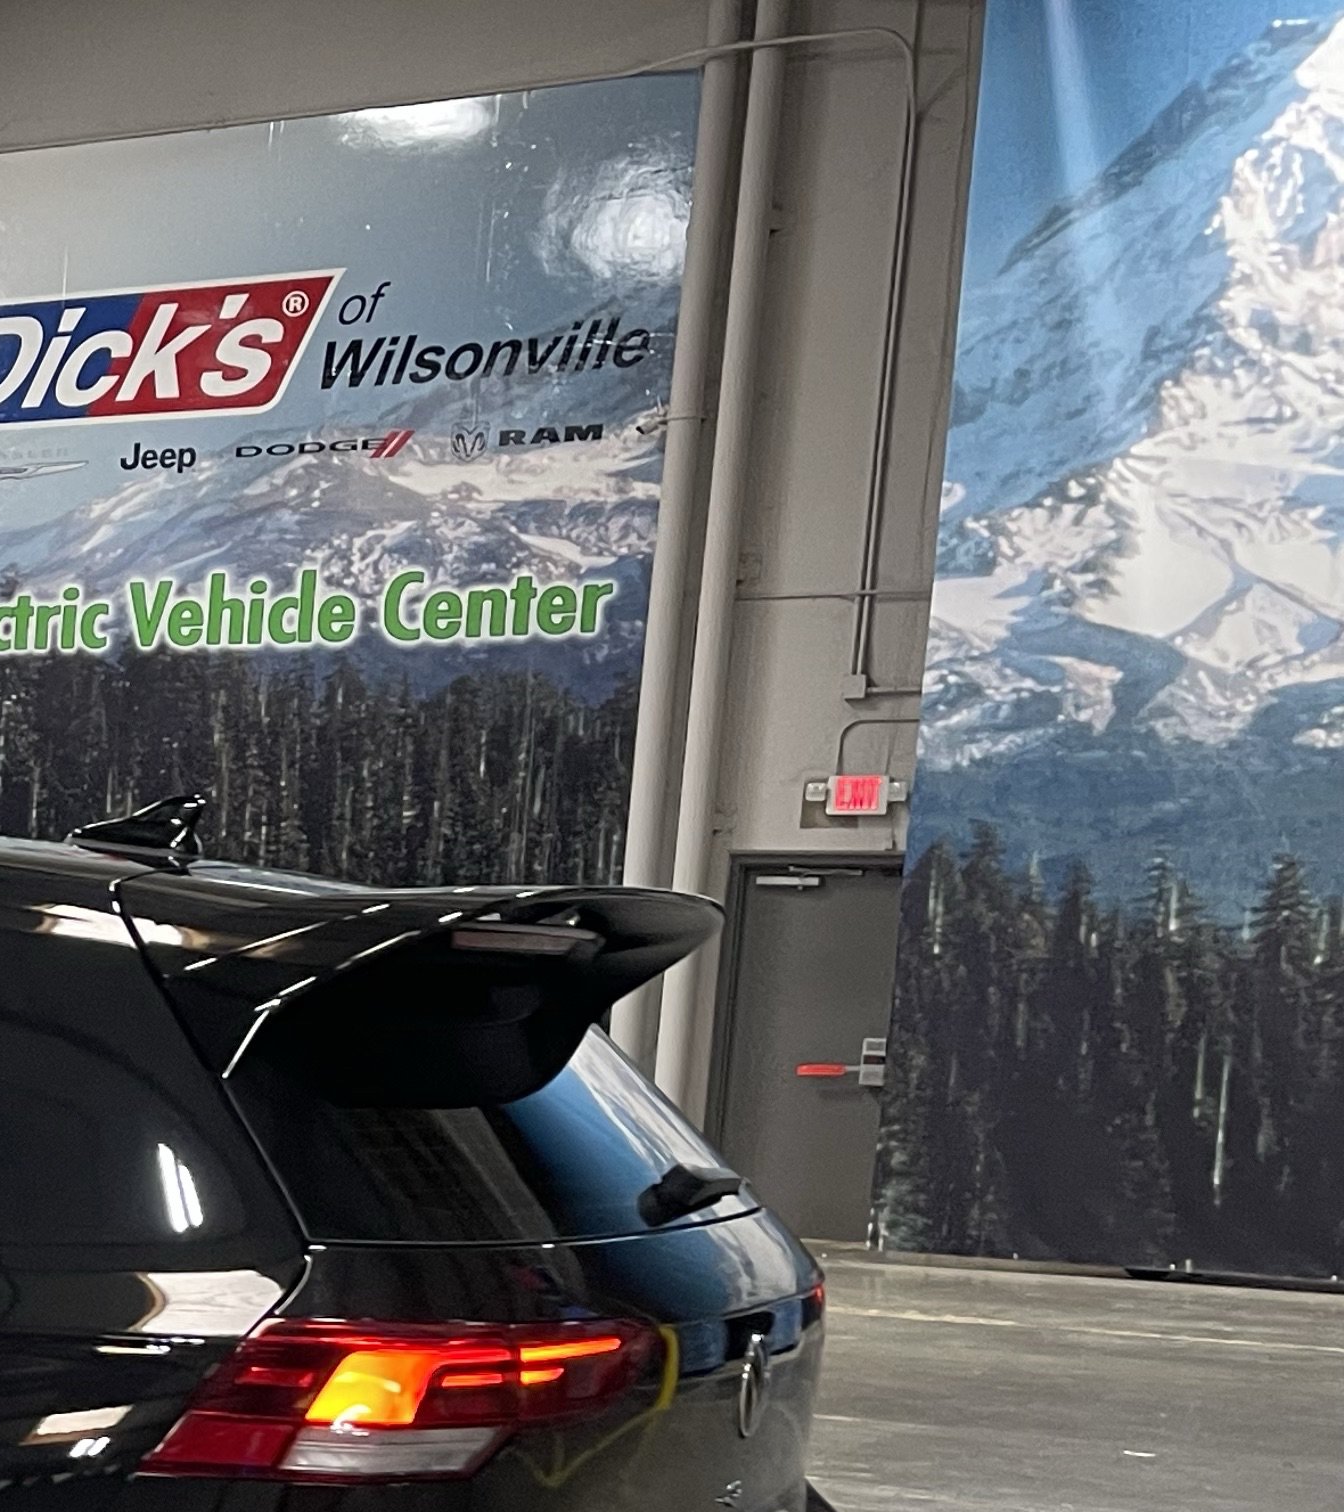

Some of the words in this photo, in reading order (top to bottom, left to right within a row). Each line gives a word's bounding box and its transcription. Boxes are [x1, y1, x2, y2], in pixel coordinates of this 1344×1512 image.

[338, 281, 391, 326] of
[321, 317, 650, 390] Wilsonville
[235, 438, 389, 458] DODGE
[498, 424, 604, 447] RAM
[120, 442, 197, 473] Jeep
[129, 569, 357, 648] Vehicle
[382, 571, 614, 642] Center
